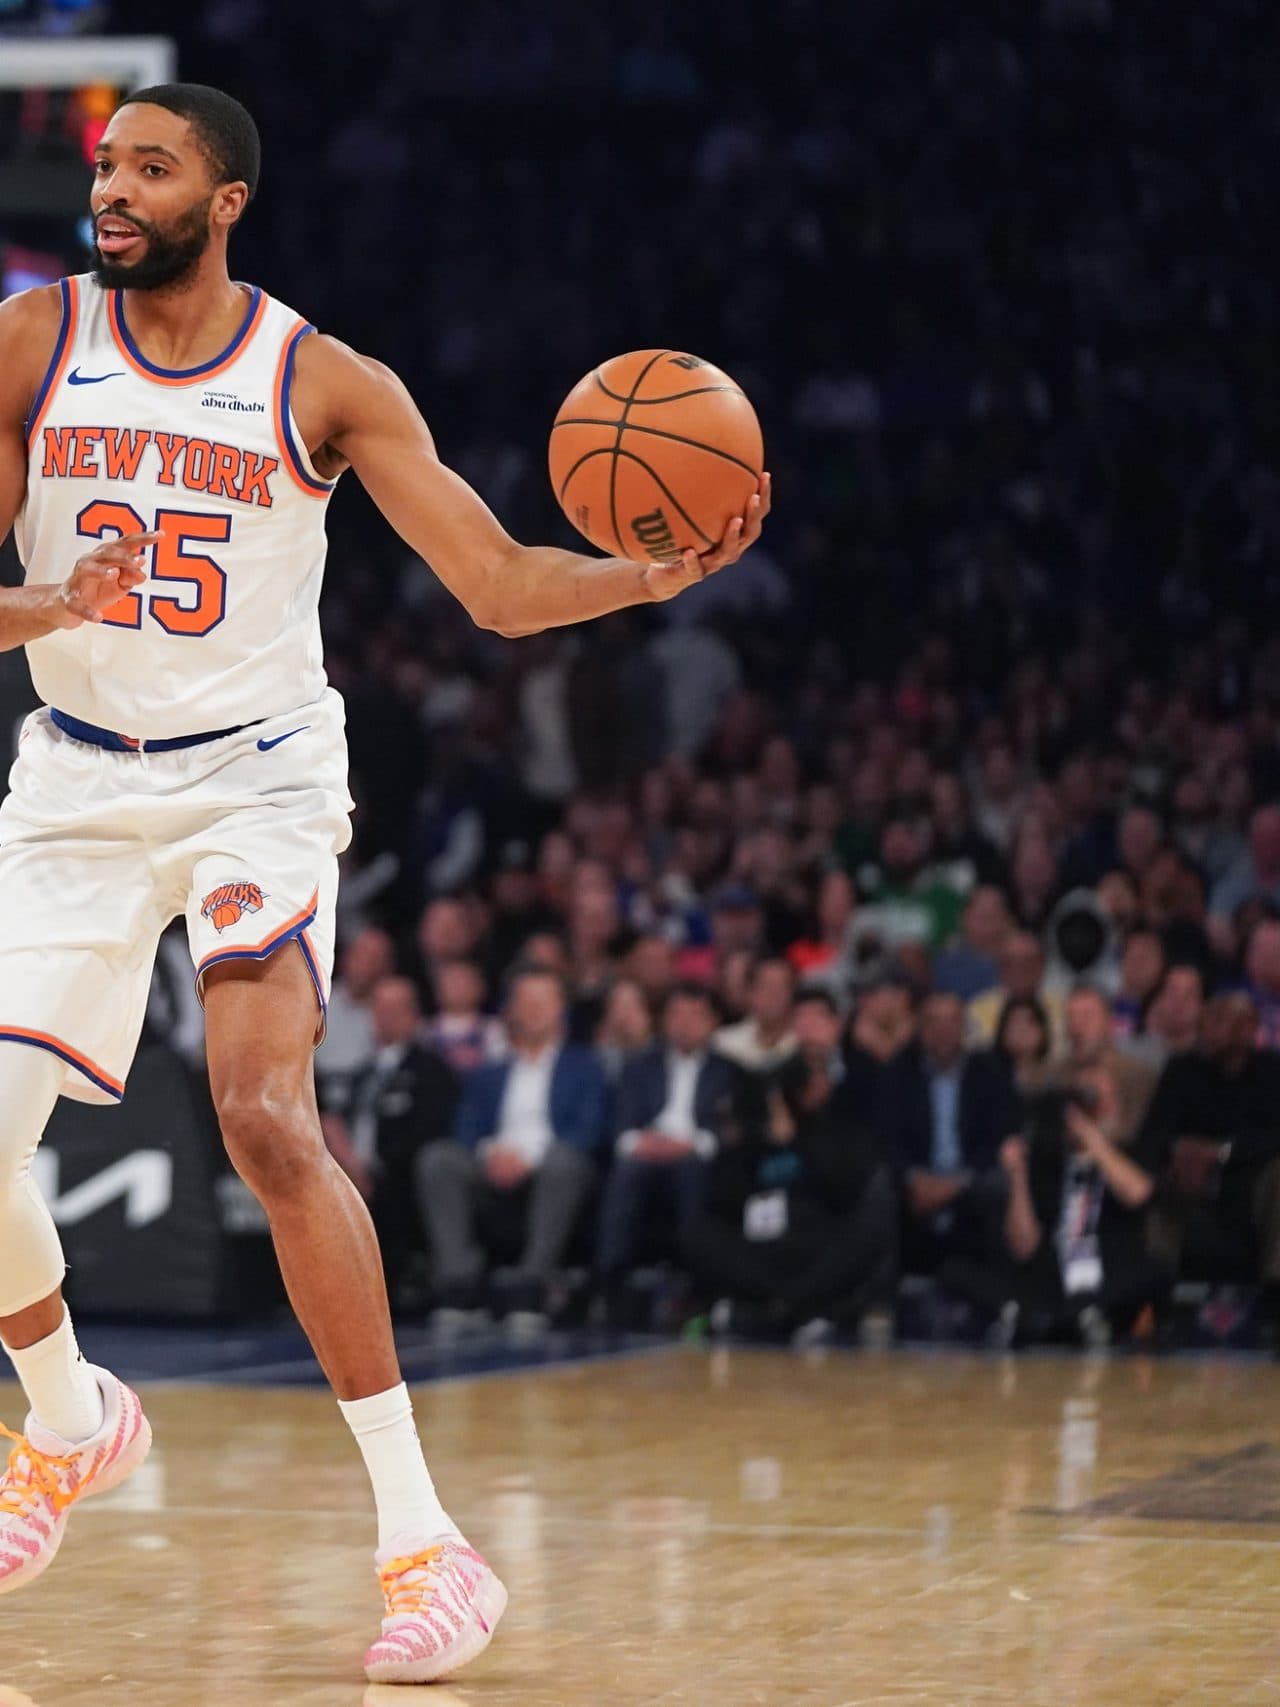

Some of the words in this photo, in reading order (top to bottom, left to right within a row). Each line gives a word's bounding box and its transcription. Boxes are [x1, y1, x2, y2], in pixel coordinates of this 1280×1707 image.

[201, 397, 226, 409] abu
[228, 400, 265, 413] dhabi
[42, 427, 150, 478] NEW
[153, 431, 280, 508] YORK
[76, 499, 232, 637] 25
[201, 882, 264, 919] KNICKS
